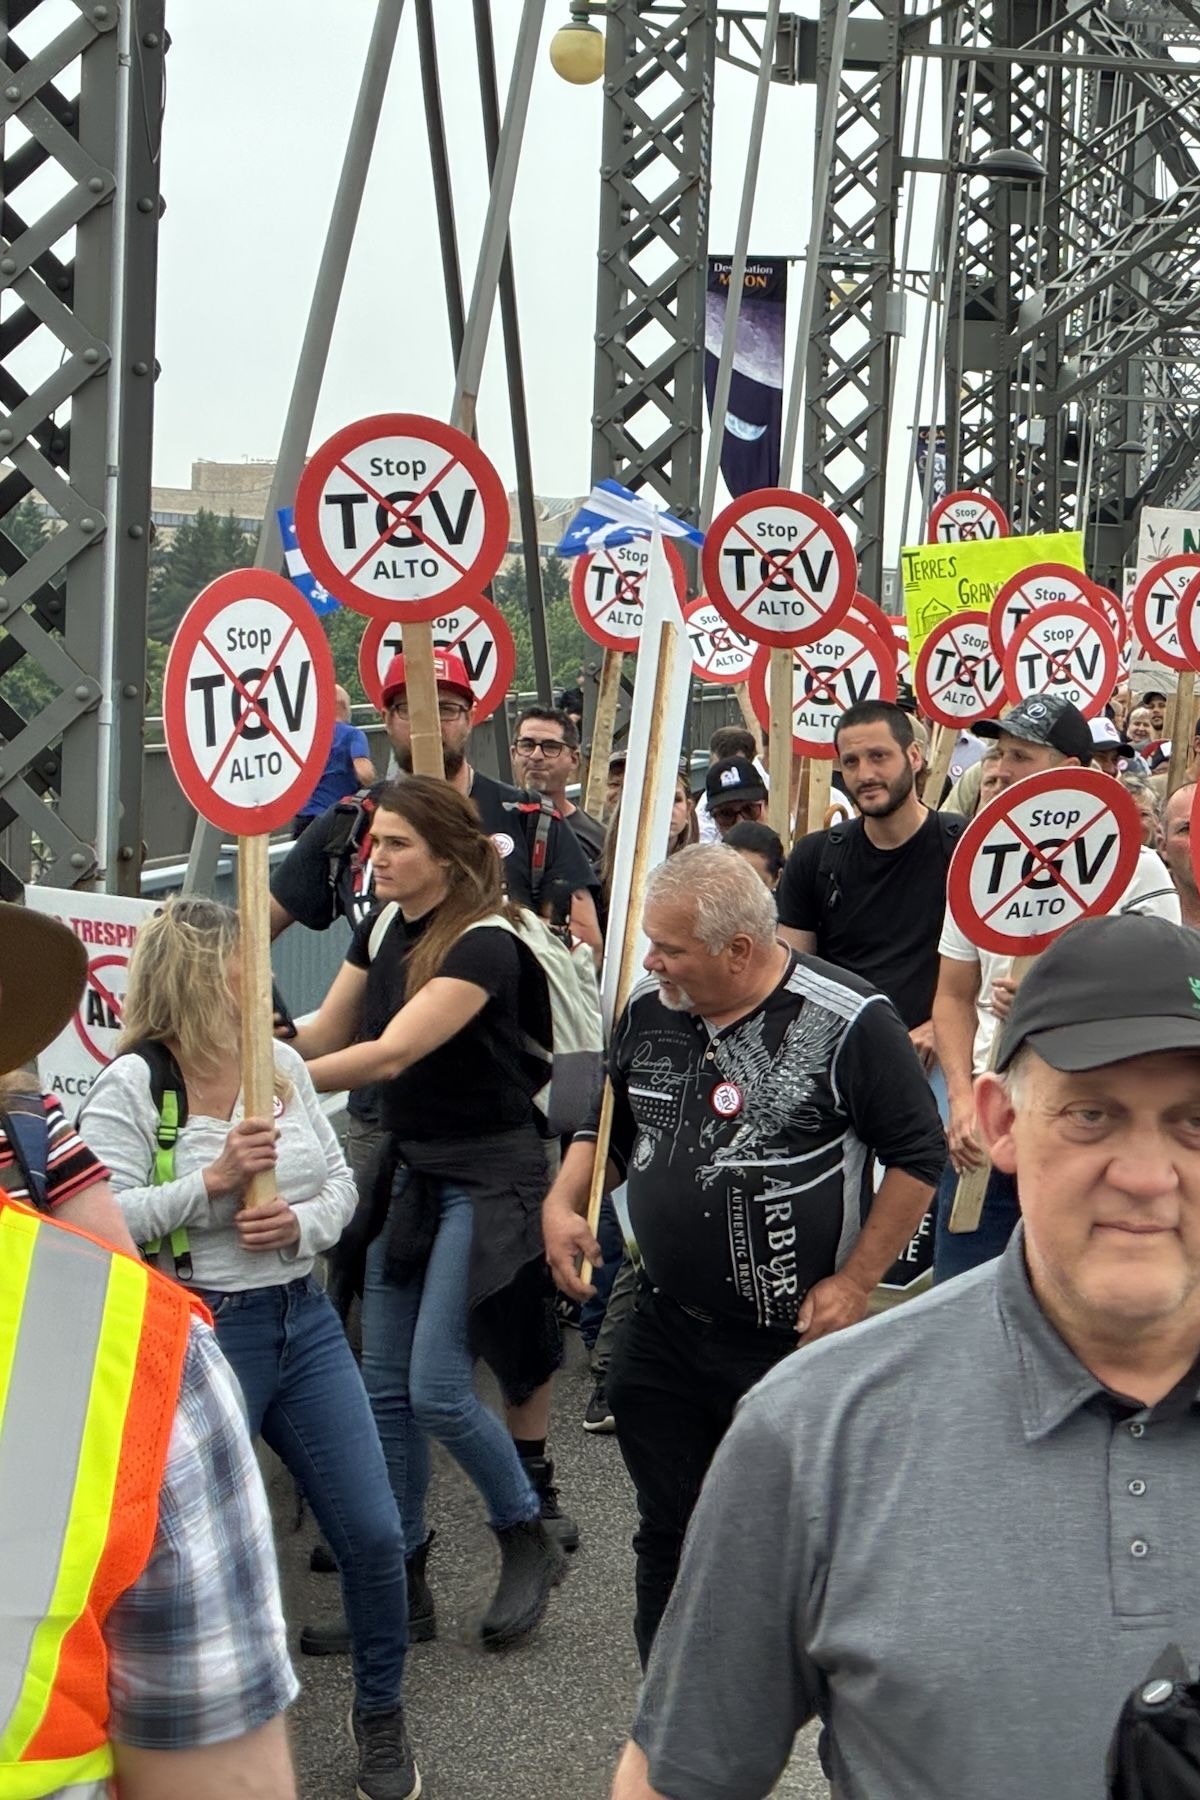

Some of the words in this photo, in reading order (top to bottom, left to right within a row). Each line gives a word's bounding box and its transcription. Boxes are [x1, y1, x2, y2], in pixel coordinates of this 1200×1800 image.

[714, 263, 773, 275] Desation
[719, 273, 767, 288] MON
[370, 457, 427, 480] Stop
[324, 489, 477, 550] TGV
[955, 508, 978, 519] Stop
[756, 522, 799, 541] Stop
[939, 520, 996, 544] TGV
[617, 547, 649, 567] Stop
[373, 558, 440, 581] ALTO
[723, 549, 834, 593] TGV
[590, 566, 648, 606] TG
[1034, 588, 1066, 603] Stop
[607, 610, 643, 627] ALTO
[757, 600, 806, 616] ALTO
[431, 615, 460, 634] top
[226, 626, 273, 655] Stop
[961, 633, 989, 650] Stop
[1043, 629, 1075, 643] Stop
[715, 654, 743, 668] ALTO
[806, 643, 845, 660] Stop
[935, 647, 1003, 692] TGV
[1019, 643, 1101, 690] TGV
[793, 664, 877, 706] GV
[190, 660, 312, 748] TGV
[942, 690, 976, 707] ALTO
[230, 751, 283, 784] ALTO
[1029, 809, 1081, 830] Stop
[981, 833, 1118, 895] TGV
[1005, 897, 1066, 920] ALTO
[732, 1186, 748, 1259] AUTHENTIC
